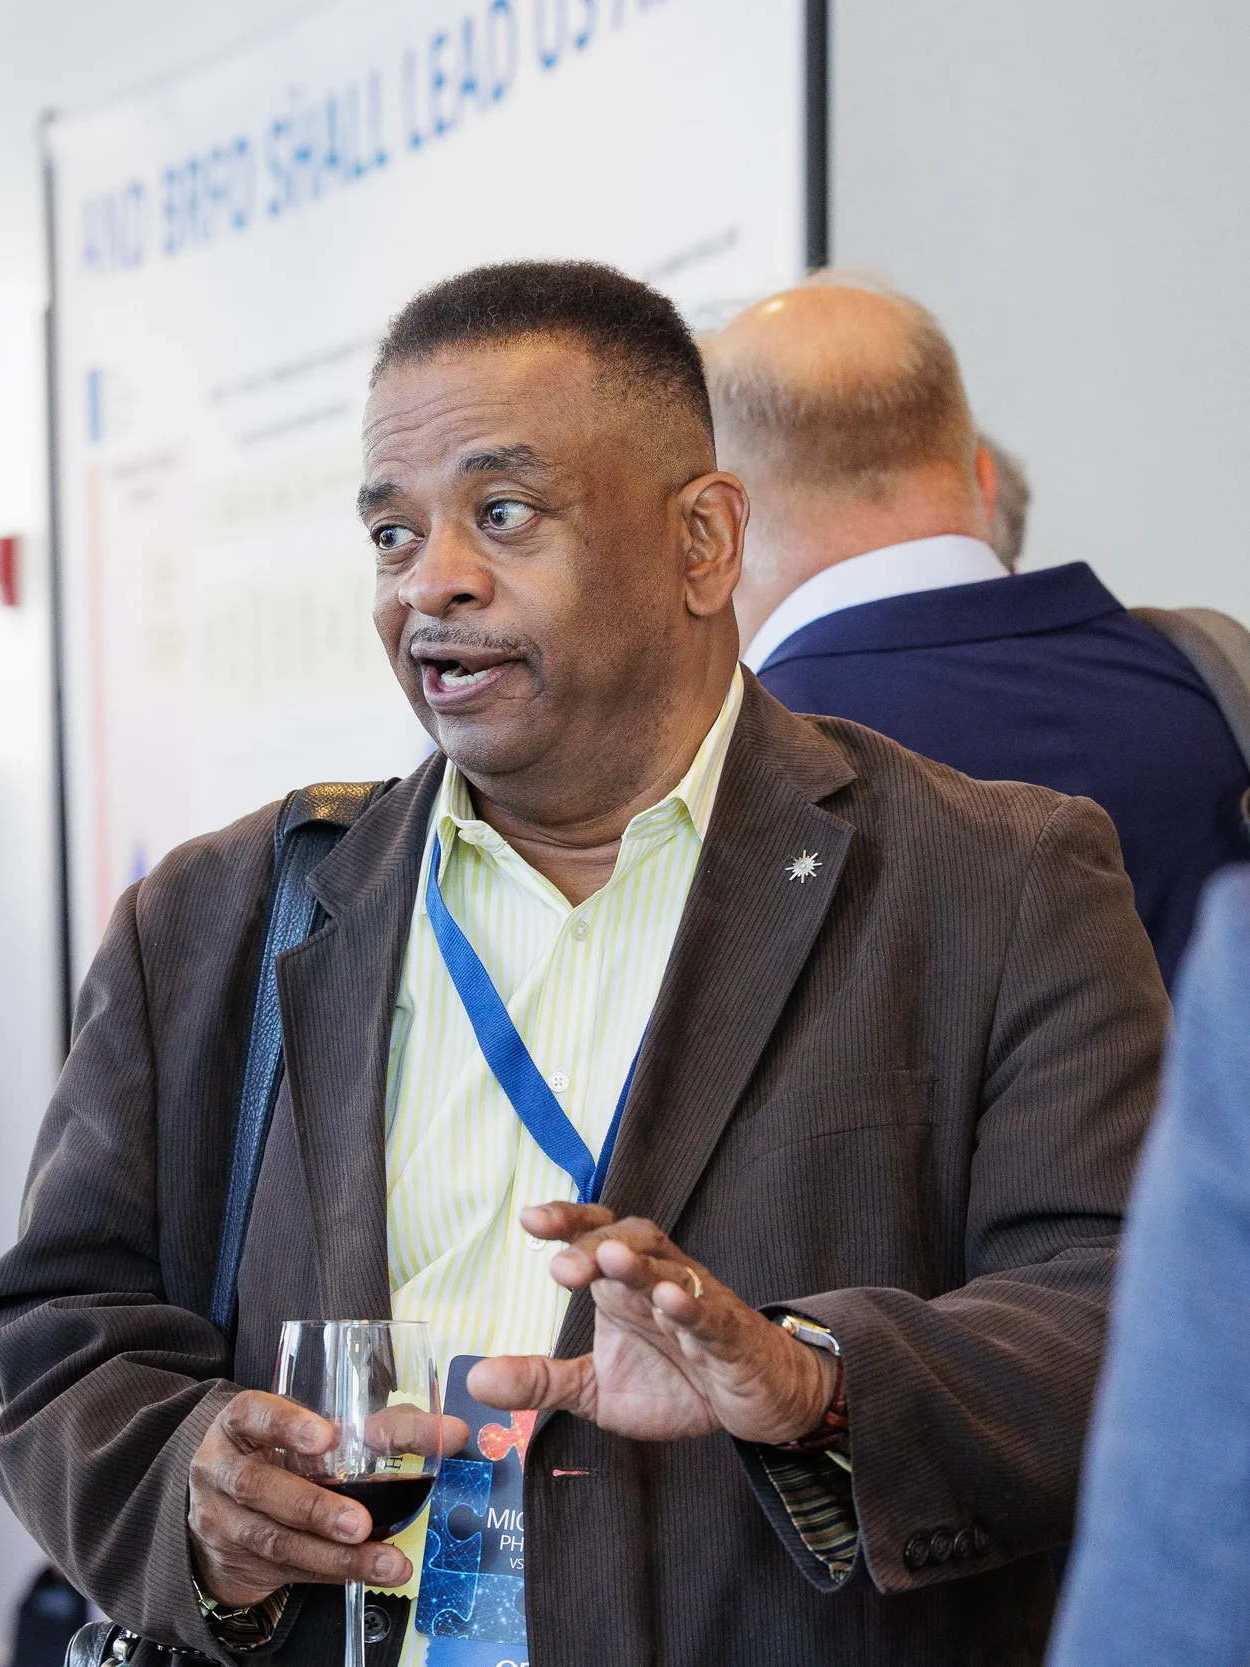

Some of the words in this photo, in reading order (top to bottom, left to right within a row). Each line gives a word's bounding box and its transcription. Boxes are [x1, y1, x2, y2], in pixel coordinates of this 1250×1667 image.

[264, 68, 390, 218] SHALL
[402, 0, 519, 152] LEAD
[499, 1534, 524, 1552] PH
